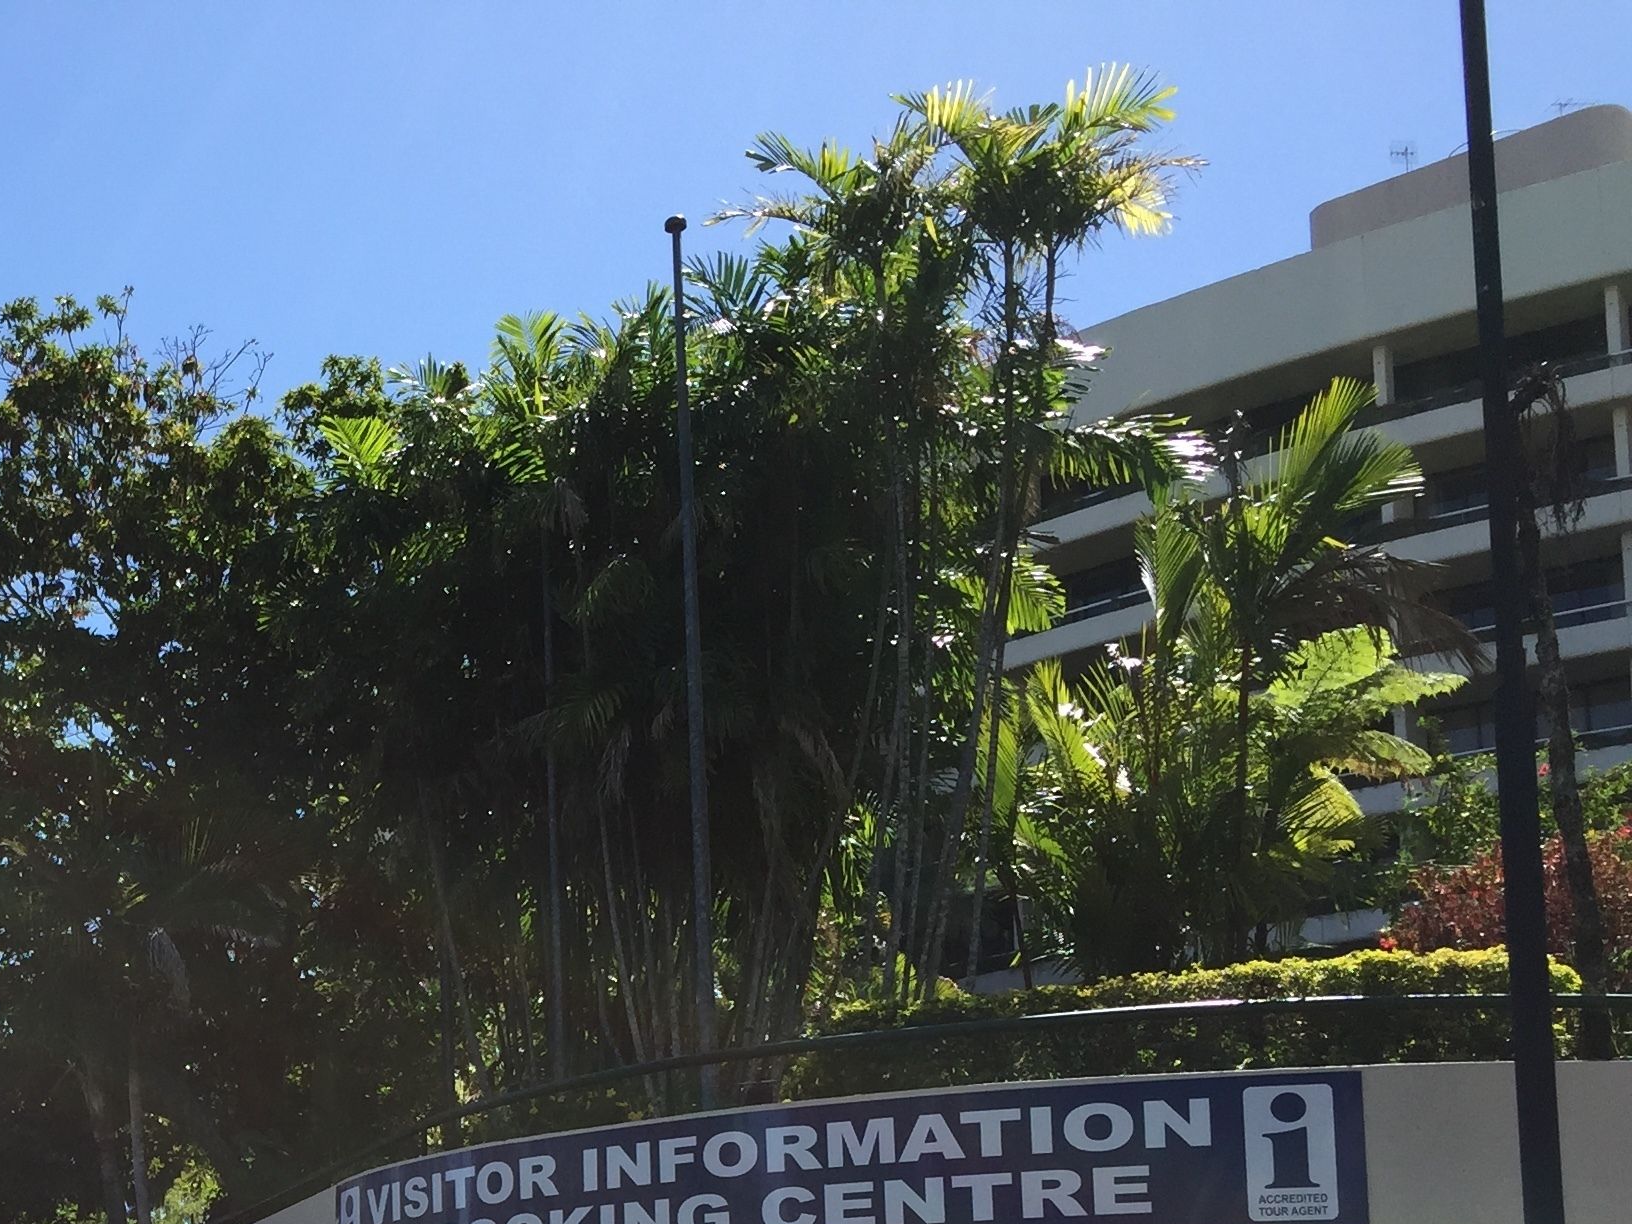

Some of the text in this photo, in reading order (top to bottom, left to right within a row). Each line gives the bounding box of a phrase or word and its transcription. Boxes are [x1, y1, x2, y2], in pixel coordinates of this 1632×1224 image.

[582, 1097, 1211, 1193] INFORMATION
[1258, 1193, 1328, 1205] ACCREDITED
[1258, 1205, 1328, 1217] TOUR AGENT
